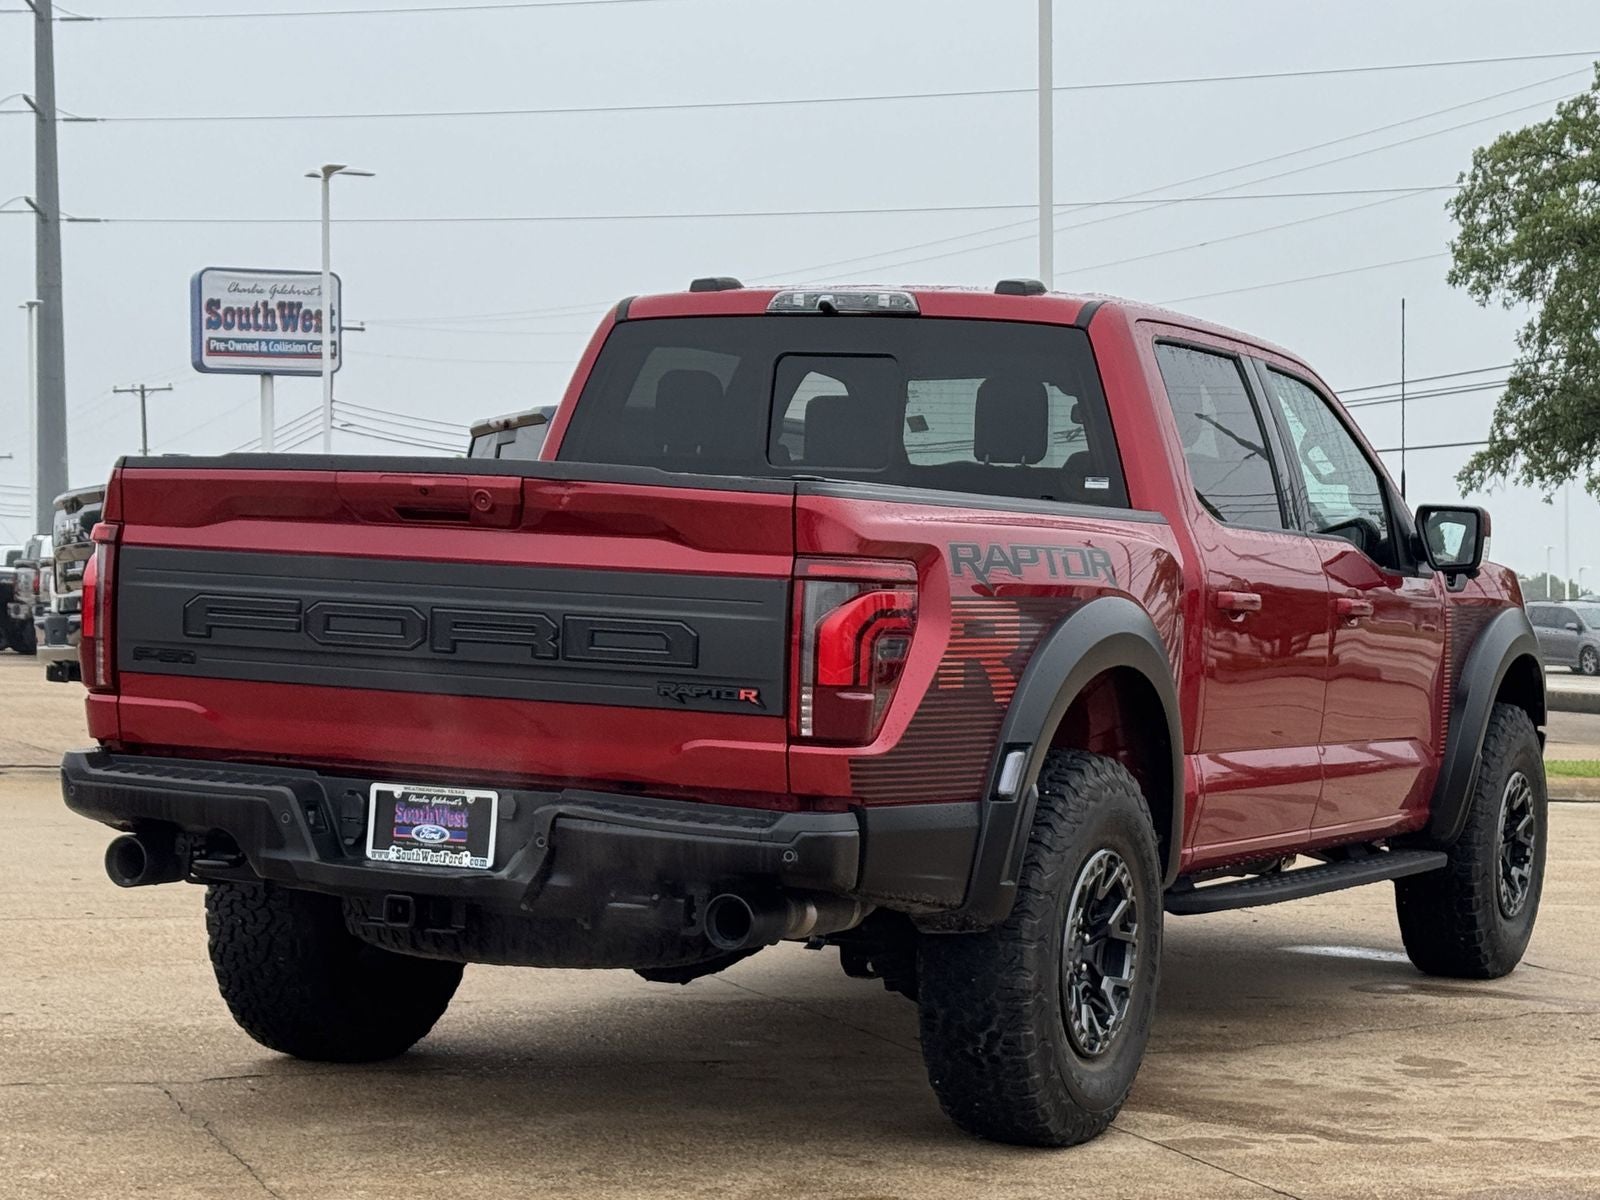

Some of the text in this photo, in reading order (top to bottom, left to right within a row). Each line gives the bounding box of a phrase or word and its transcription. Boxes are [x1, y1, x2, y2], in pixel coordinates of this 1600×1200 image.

[210, 340, 259, 351] Pre-Owned
[260, 341, 268, 352] &
[269, 342, 306, 353] Collision
[947, 541, 1119, 595] RAPTOR
[182, 593, 699, 668] FORD
[657, 681, 767, 709] RAPTOR
[394, 801, 469, 828] SouthWest
[419, 828, 442, 839] Ford
